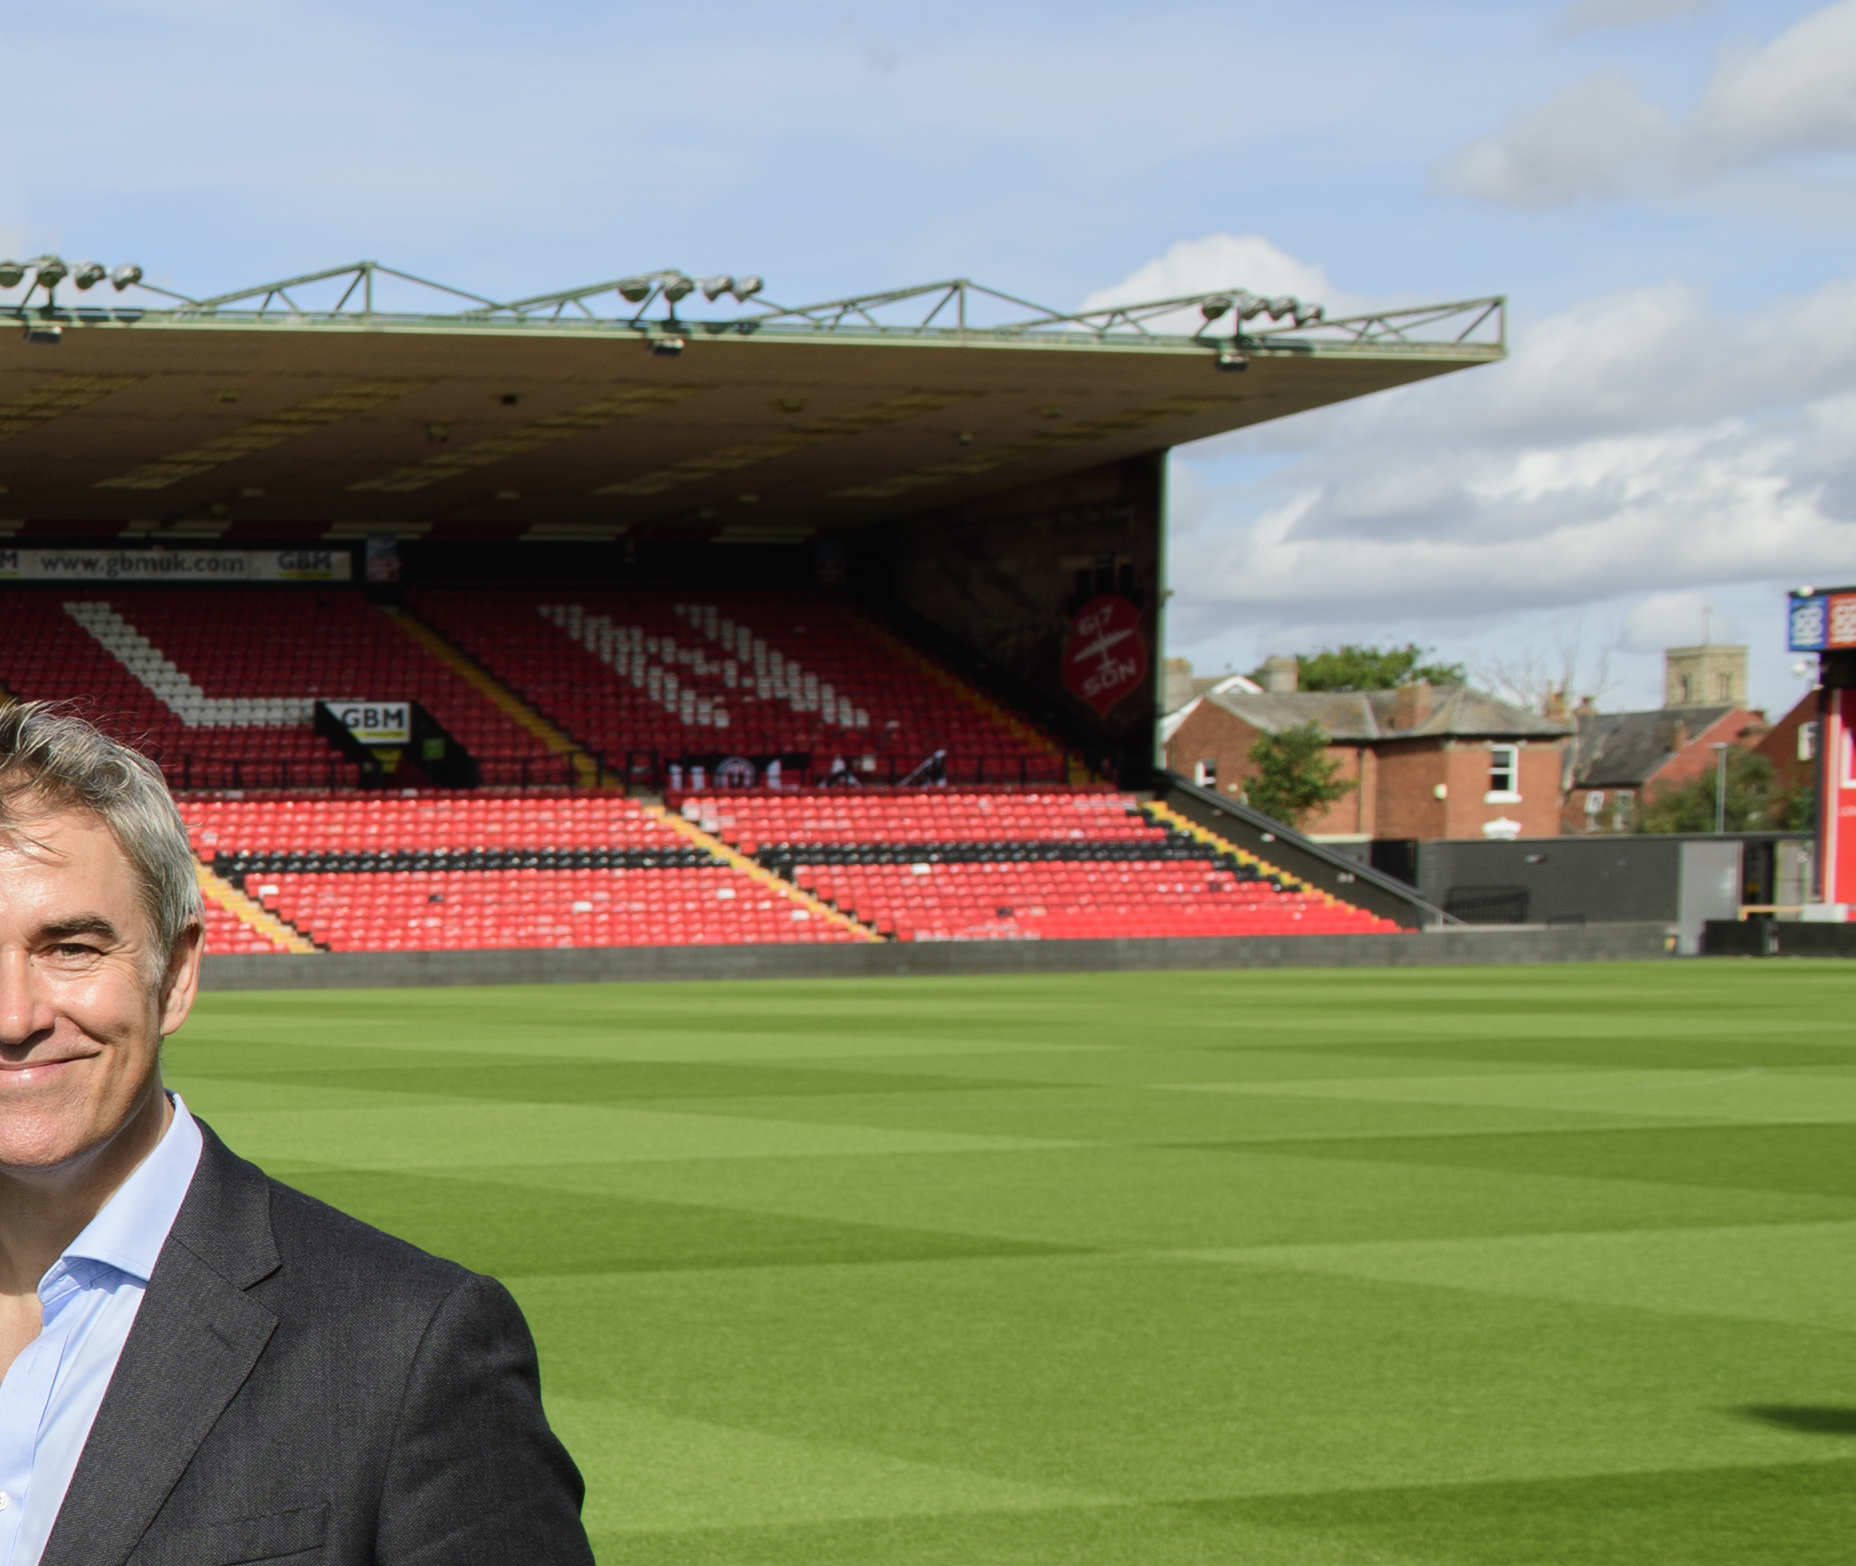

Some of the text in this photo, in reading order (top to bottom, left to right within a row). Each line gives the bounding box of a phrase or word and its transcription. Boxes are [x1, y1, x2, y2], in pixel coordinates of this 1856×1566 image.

[41, 552, 245, 576] www.gbmuk.com
[277, 552, 332, 571] GBM
[341, 708, 404, 729] GBM
